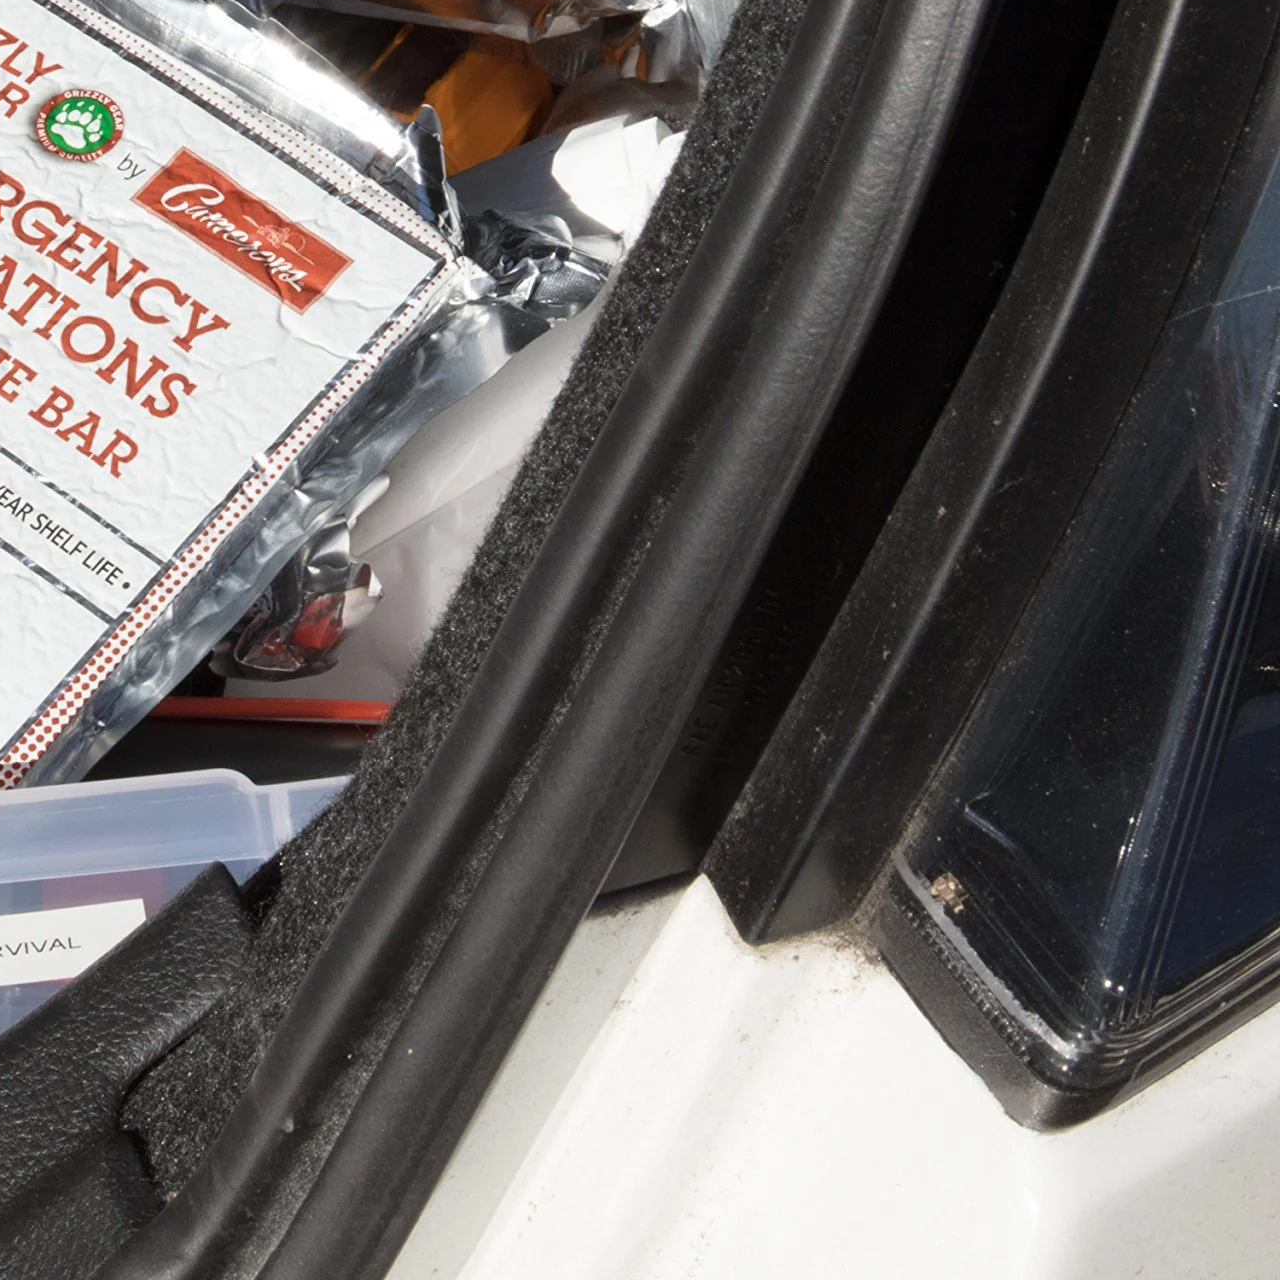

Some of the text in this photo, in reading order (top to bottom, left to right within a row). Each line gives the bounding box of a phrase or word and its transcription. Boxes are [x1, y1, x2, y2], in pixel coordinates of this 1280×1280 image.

[64, 89, 124, 131] GRIZZLY GEAR
[116, 152, 146, 181] by
[160, 183, 308, 293] Camerons
[27, 384, 139, 479] BAR
[28, 512, 88, 556] SHELF
[81, 549, 124, 586] LIFE
